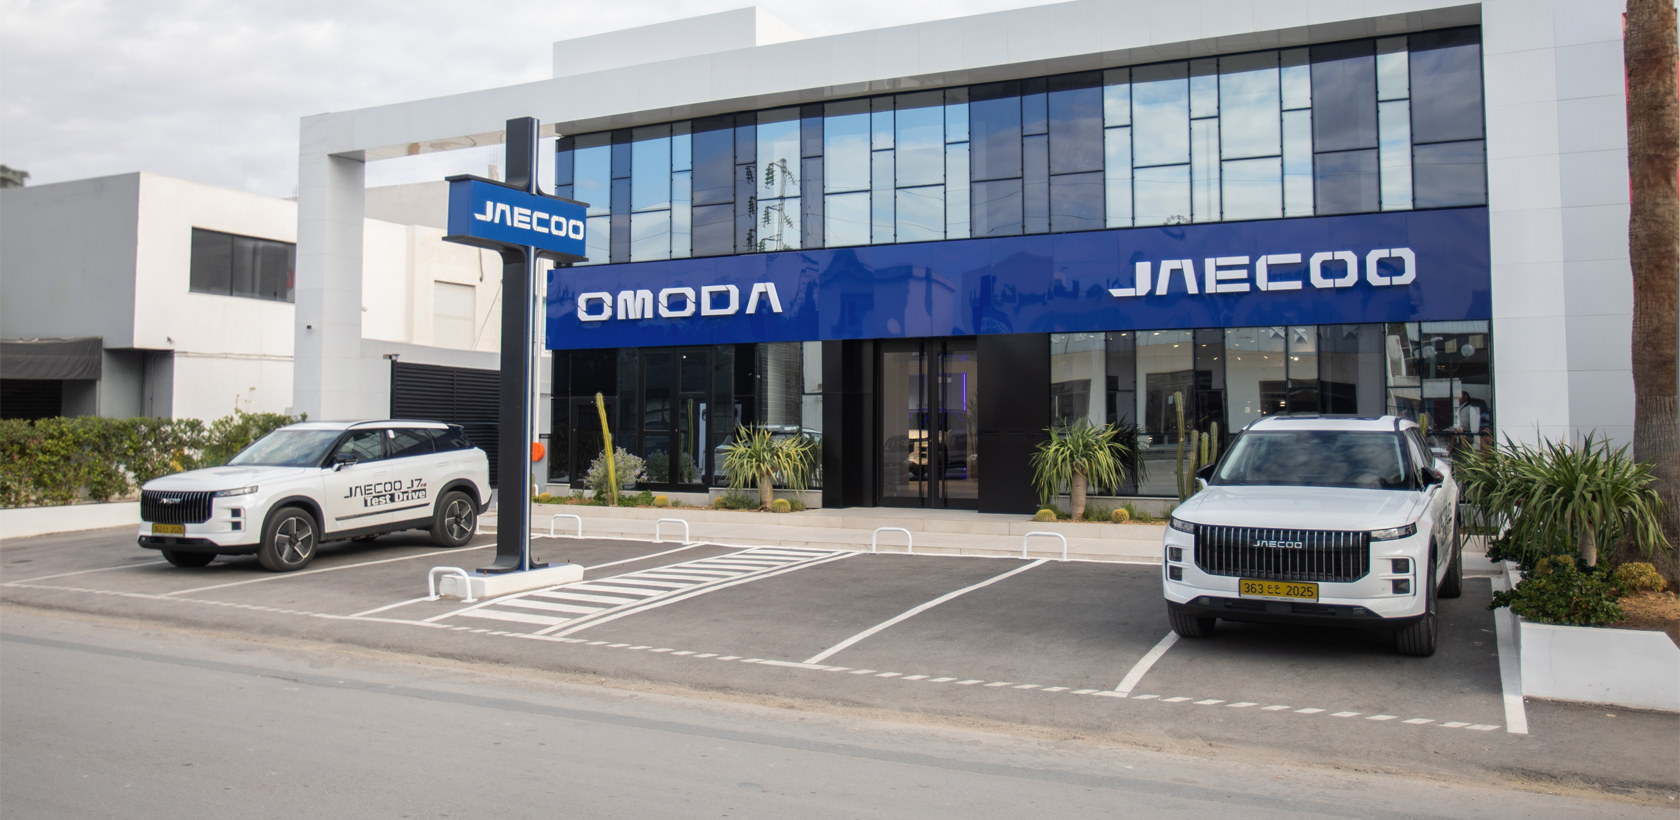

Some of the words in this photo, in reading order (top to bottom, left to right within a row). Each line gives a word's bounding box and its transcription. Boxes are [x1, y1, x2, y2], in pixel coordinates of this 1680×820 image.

[473, 200, 584, 241] JAECOO
[1108, 247, 1416, 297] JAECOO
[577, 282, 783, 322] OMODA
[343, 480, 402, 499] JAECOO
[406, 478, 423, 489] J7
[364, 494, 392, 507] Test
[394, 489, 426, 502] Drive
[1253, 540, 1302, 549] JAECOO
[1244, 582, 1264, 594] 363
[1286, 585, 1314, 597] 2025
